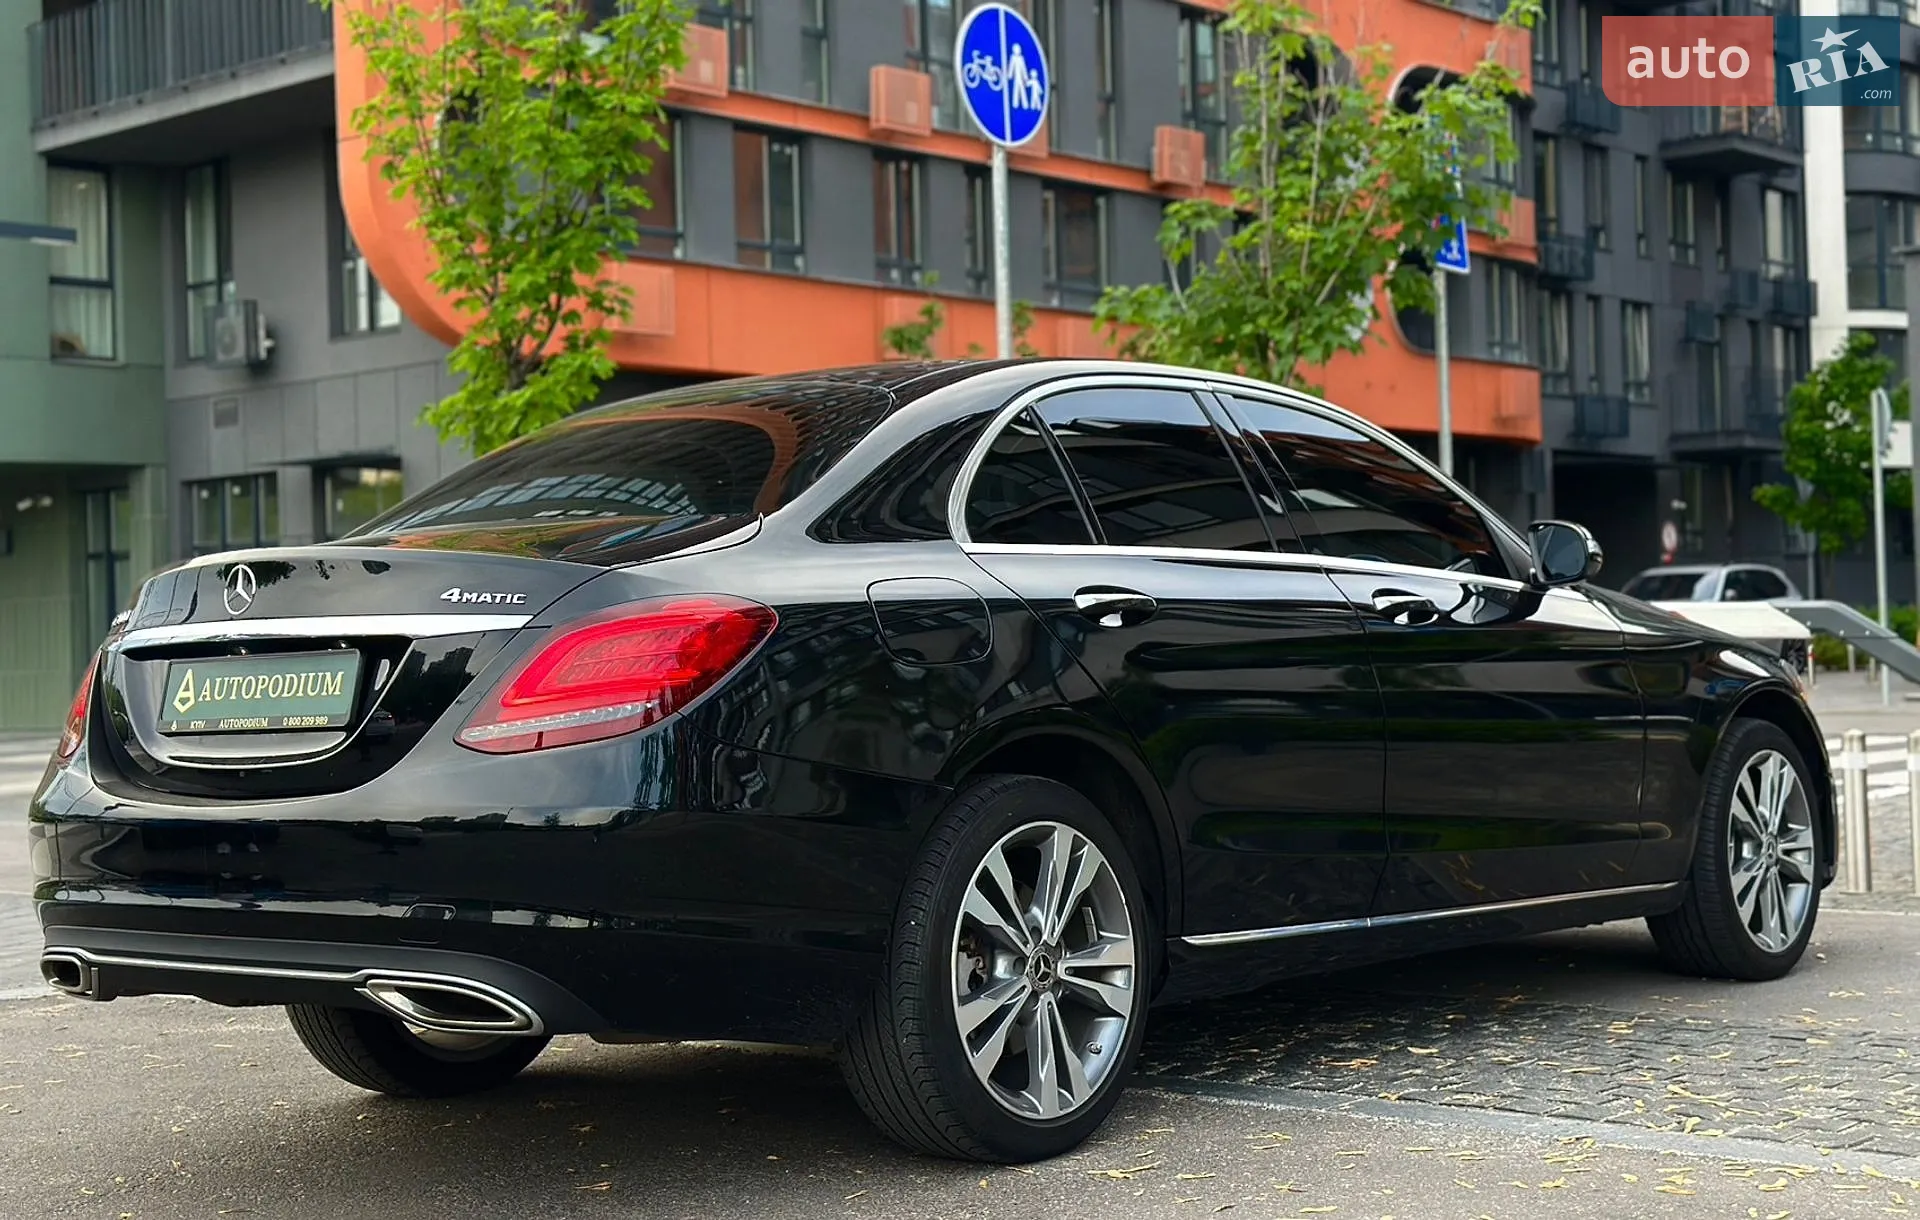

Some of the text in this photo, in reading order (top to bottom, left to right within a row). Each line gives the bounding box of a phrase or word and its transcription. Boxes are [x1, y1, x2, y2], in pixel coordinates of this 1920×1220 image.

[440, 587, 527, 604] 4MATIC
[198, 671, 345, 702] AUTOPODIUM
[218, 717, 268, 729] AUTOPODIUM
